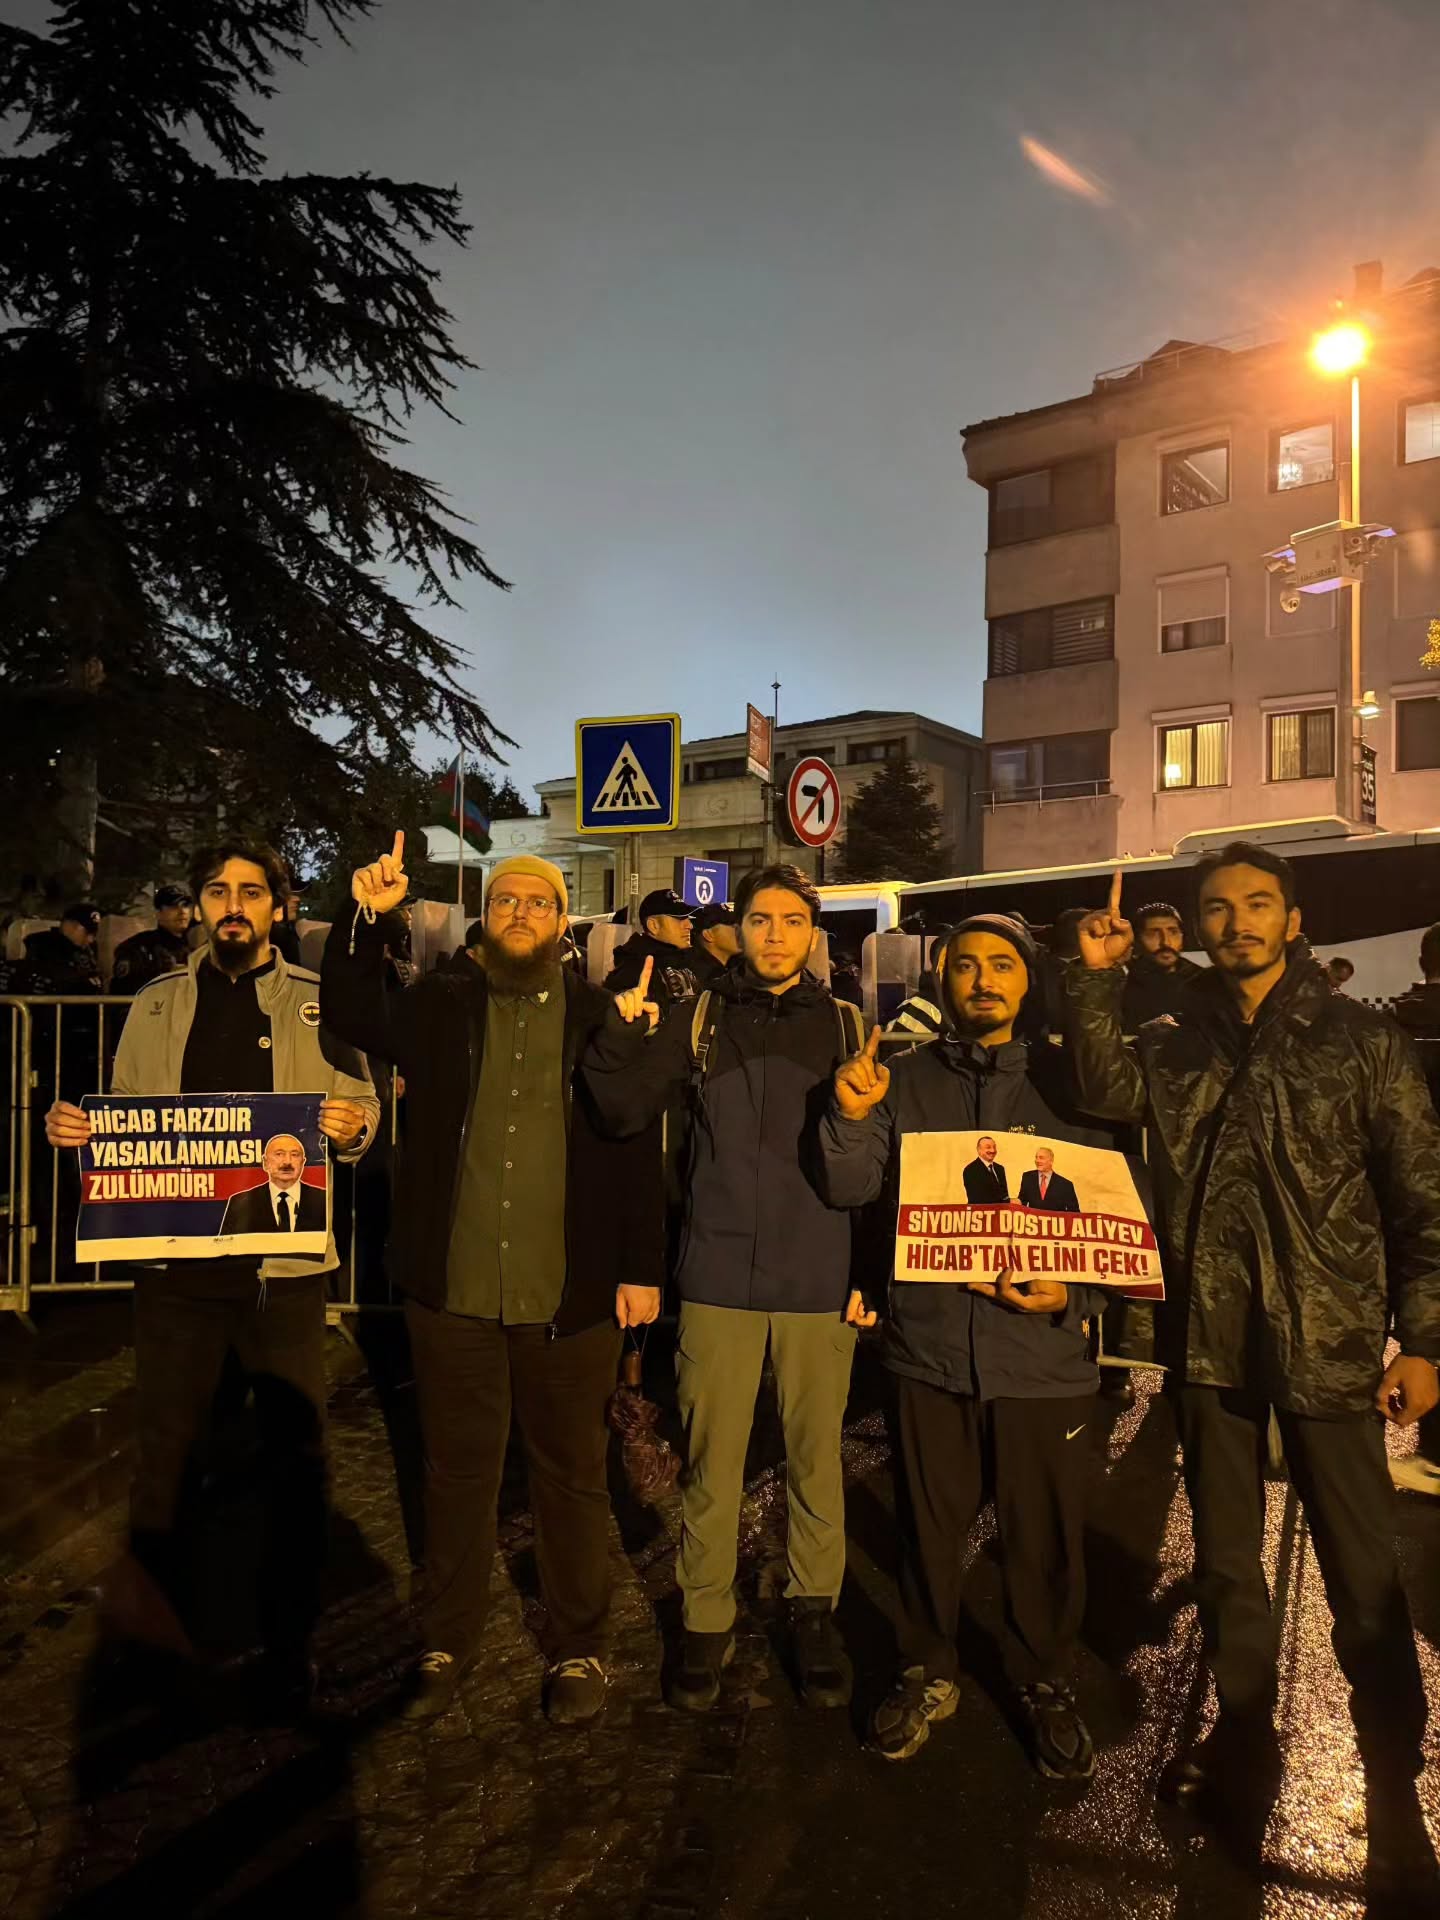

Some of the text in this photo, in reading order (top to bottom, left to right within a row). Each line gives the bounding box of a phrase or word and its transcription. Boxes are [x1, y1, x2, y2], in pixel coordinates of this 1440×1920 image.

[1361, 770, 1375, 803] 35
[88, 1105, 252, 1135] HİCAB FARZDIR
[89, 1138, 263, 1167] YASAKLANMASI
[88, 1167, 215, 1200] ZULÜMDÜR!
[908, 1206, 1143, 1246] SİYONİST DOSTU ALİYEV
[906, 1239, 1149, 1280] HİCAB'TAN ELİNİ ÇEK!
